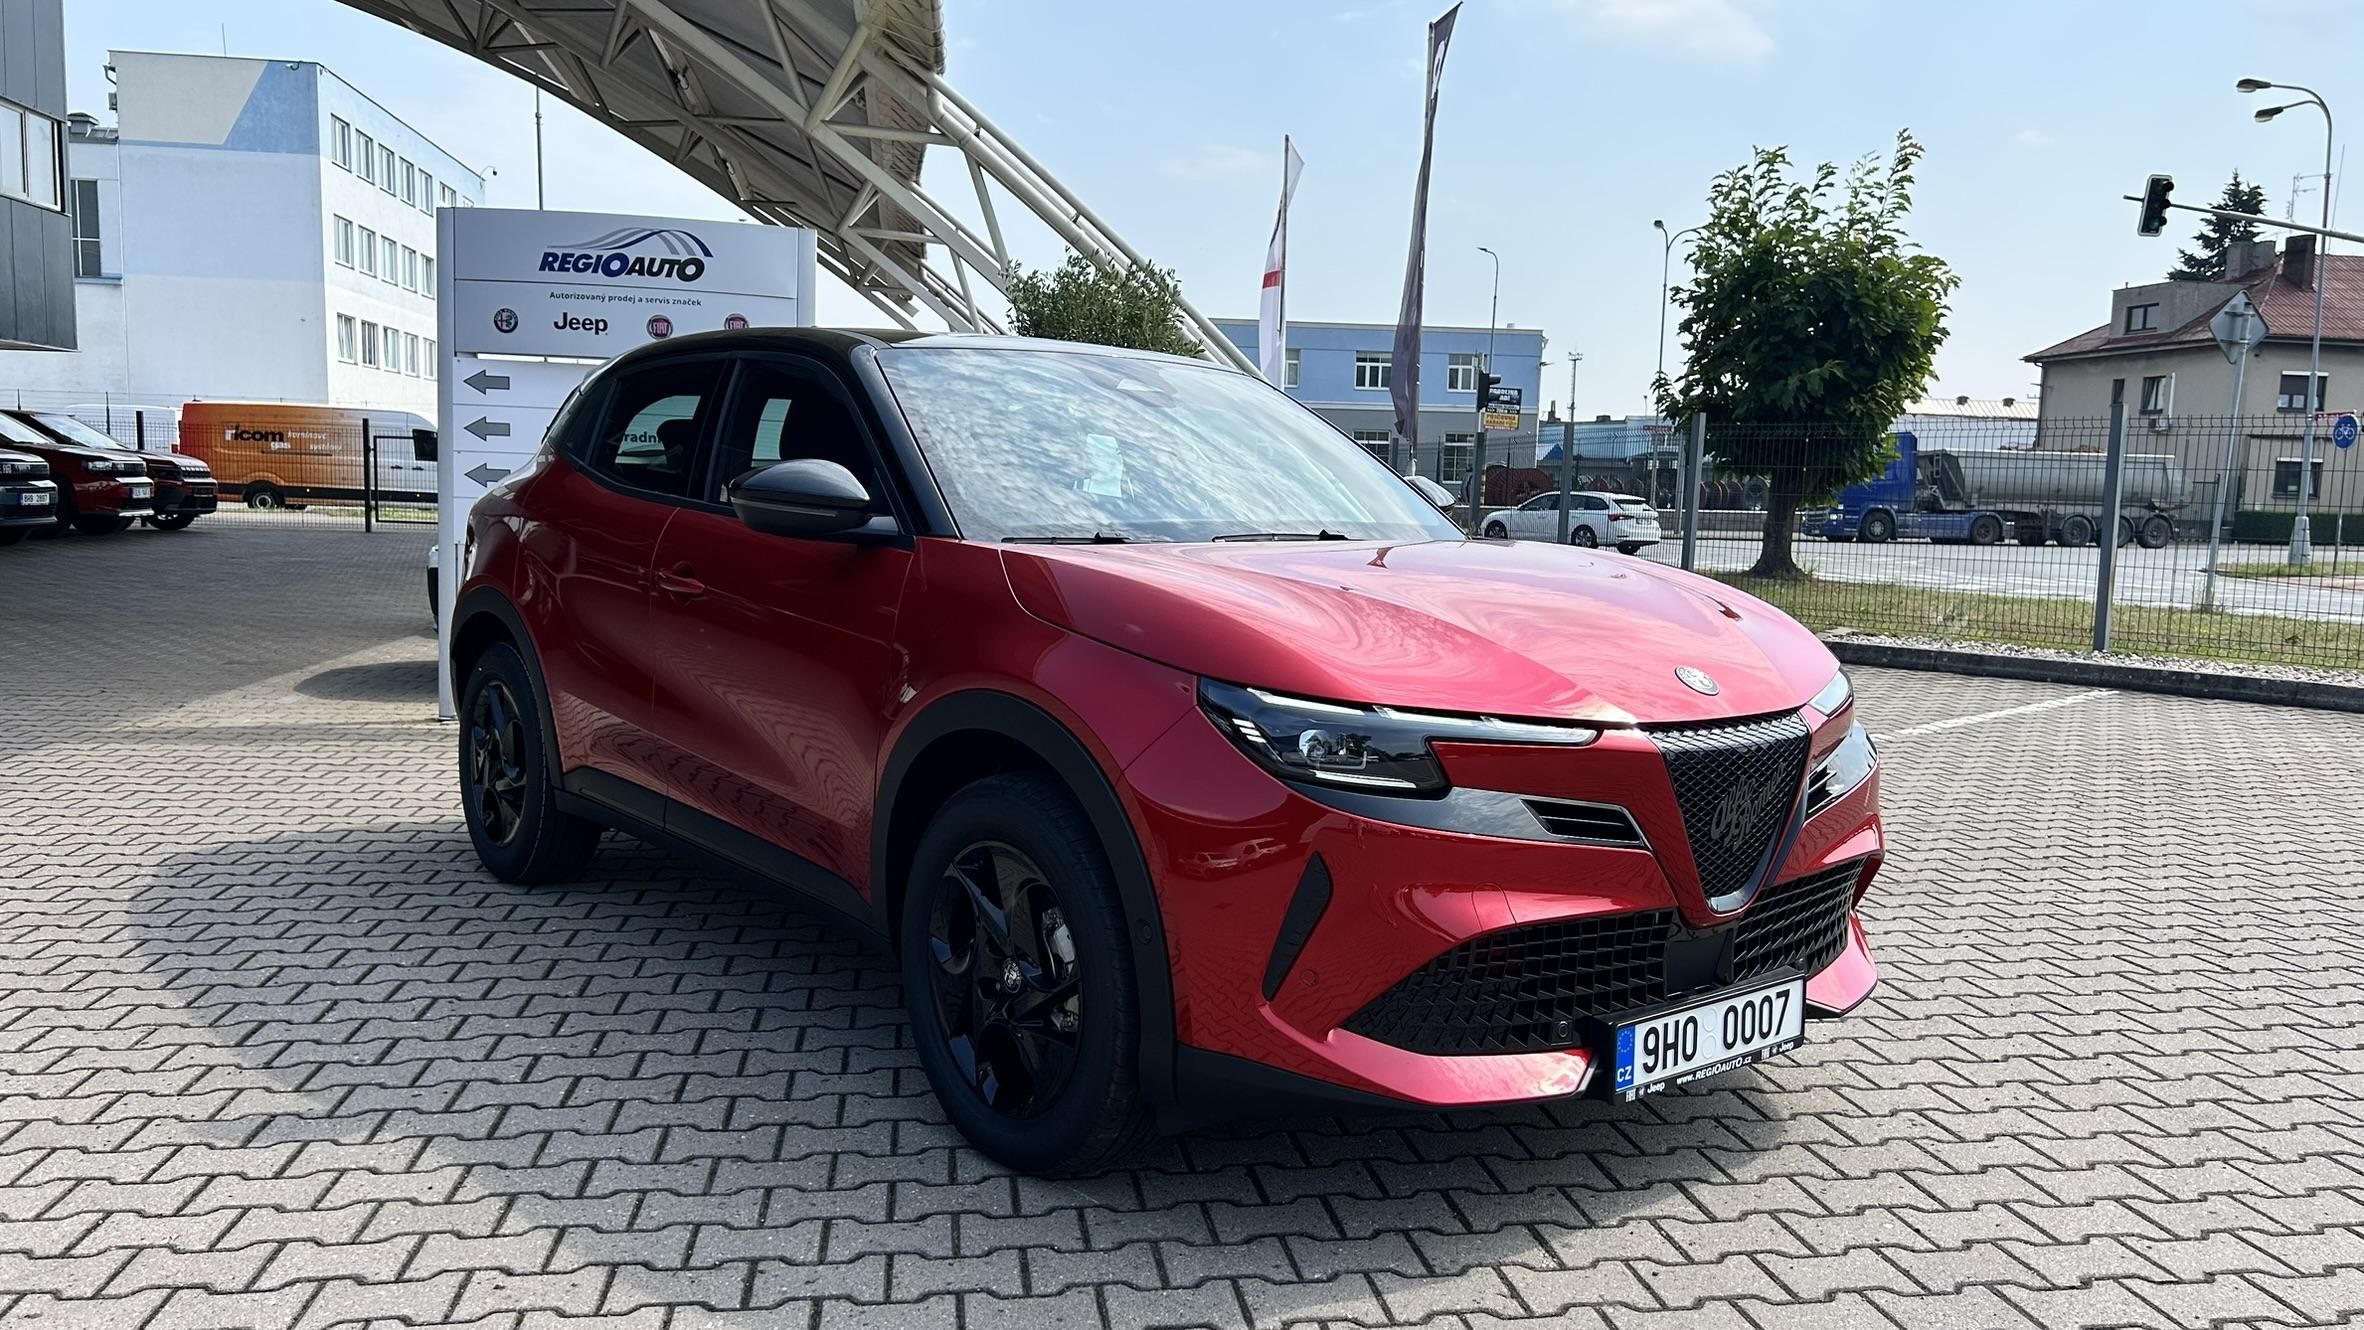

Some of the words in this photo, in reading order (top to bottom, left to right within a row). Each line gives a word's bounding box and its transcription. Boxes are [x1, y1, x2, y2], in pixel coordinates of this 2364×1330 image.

[538, 251, 705, 282] REGIOAUTO
[549, 291, 606, 303] Autorizovaný
[608, 294, 636, 305] prodej
[645, 297, 671, 305] servis
[672, 298, 702, 307] značek
[553, 311, 608, 336] Jeep
[653, 321, 669, 334] FIAT
[1642, 1015, 1698, 1074] 9H0
[1723, 988, 1791, 1051] 0007
[1779, 1041, 1794, 1054] Jeep
[1616, 1065, 1632, 1082] CZ
[1647, 1081, 1665, 1095] Jeep
